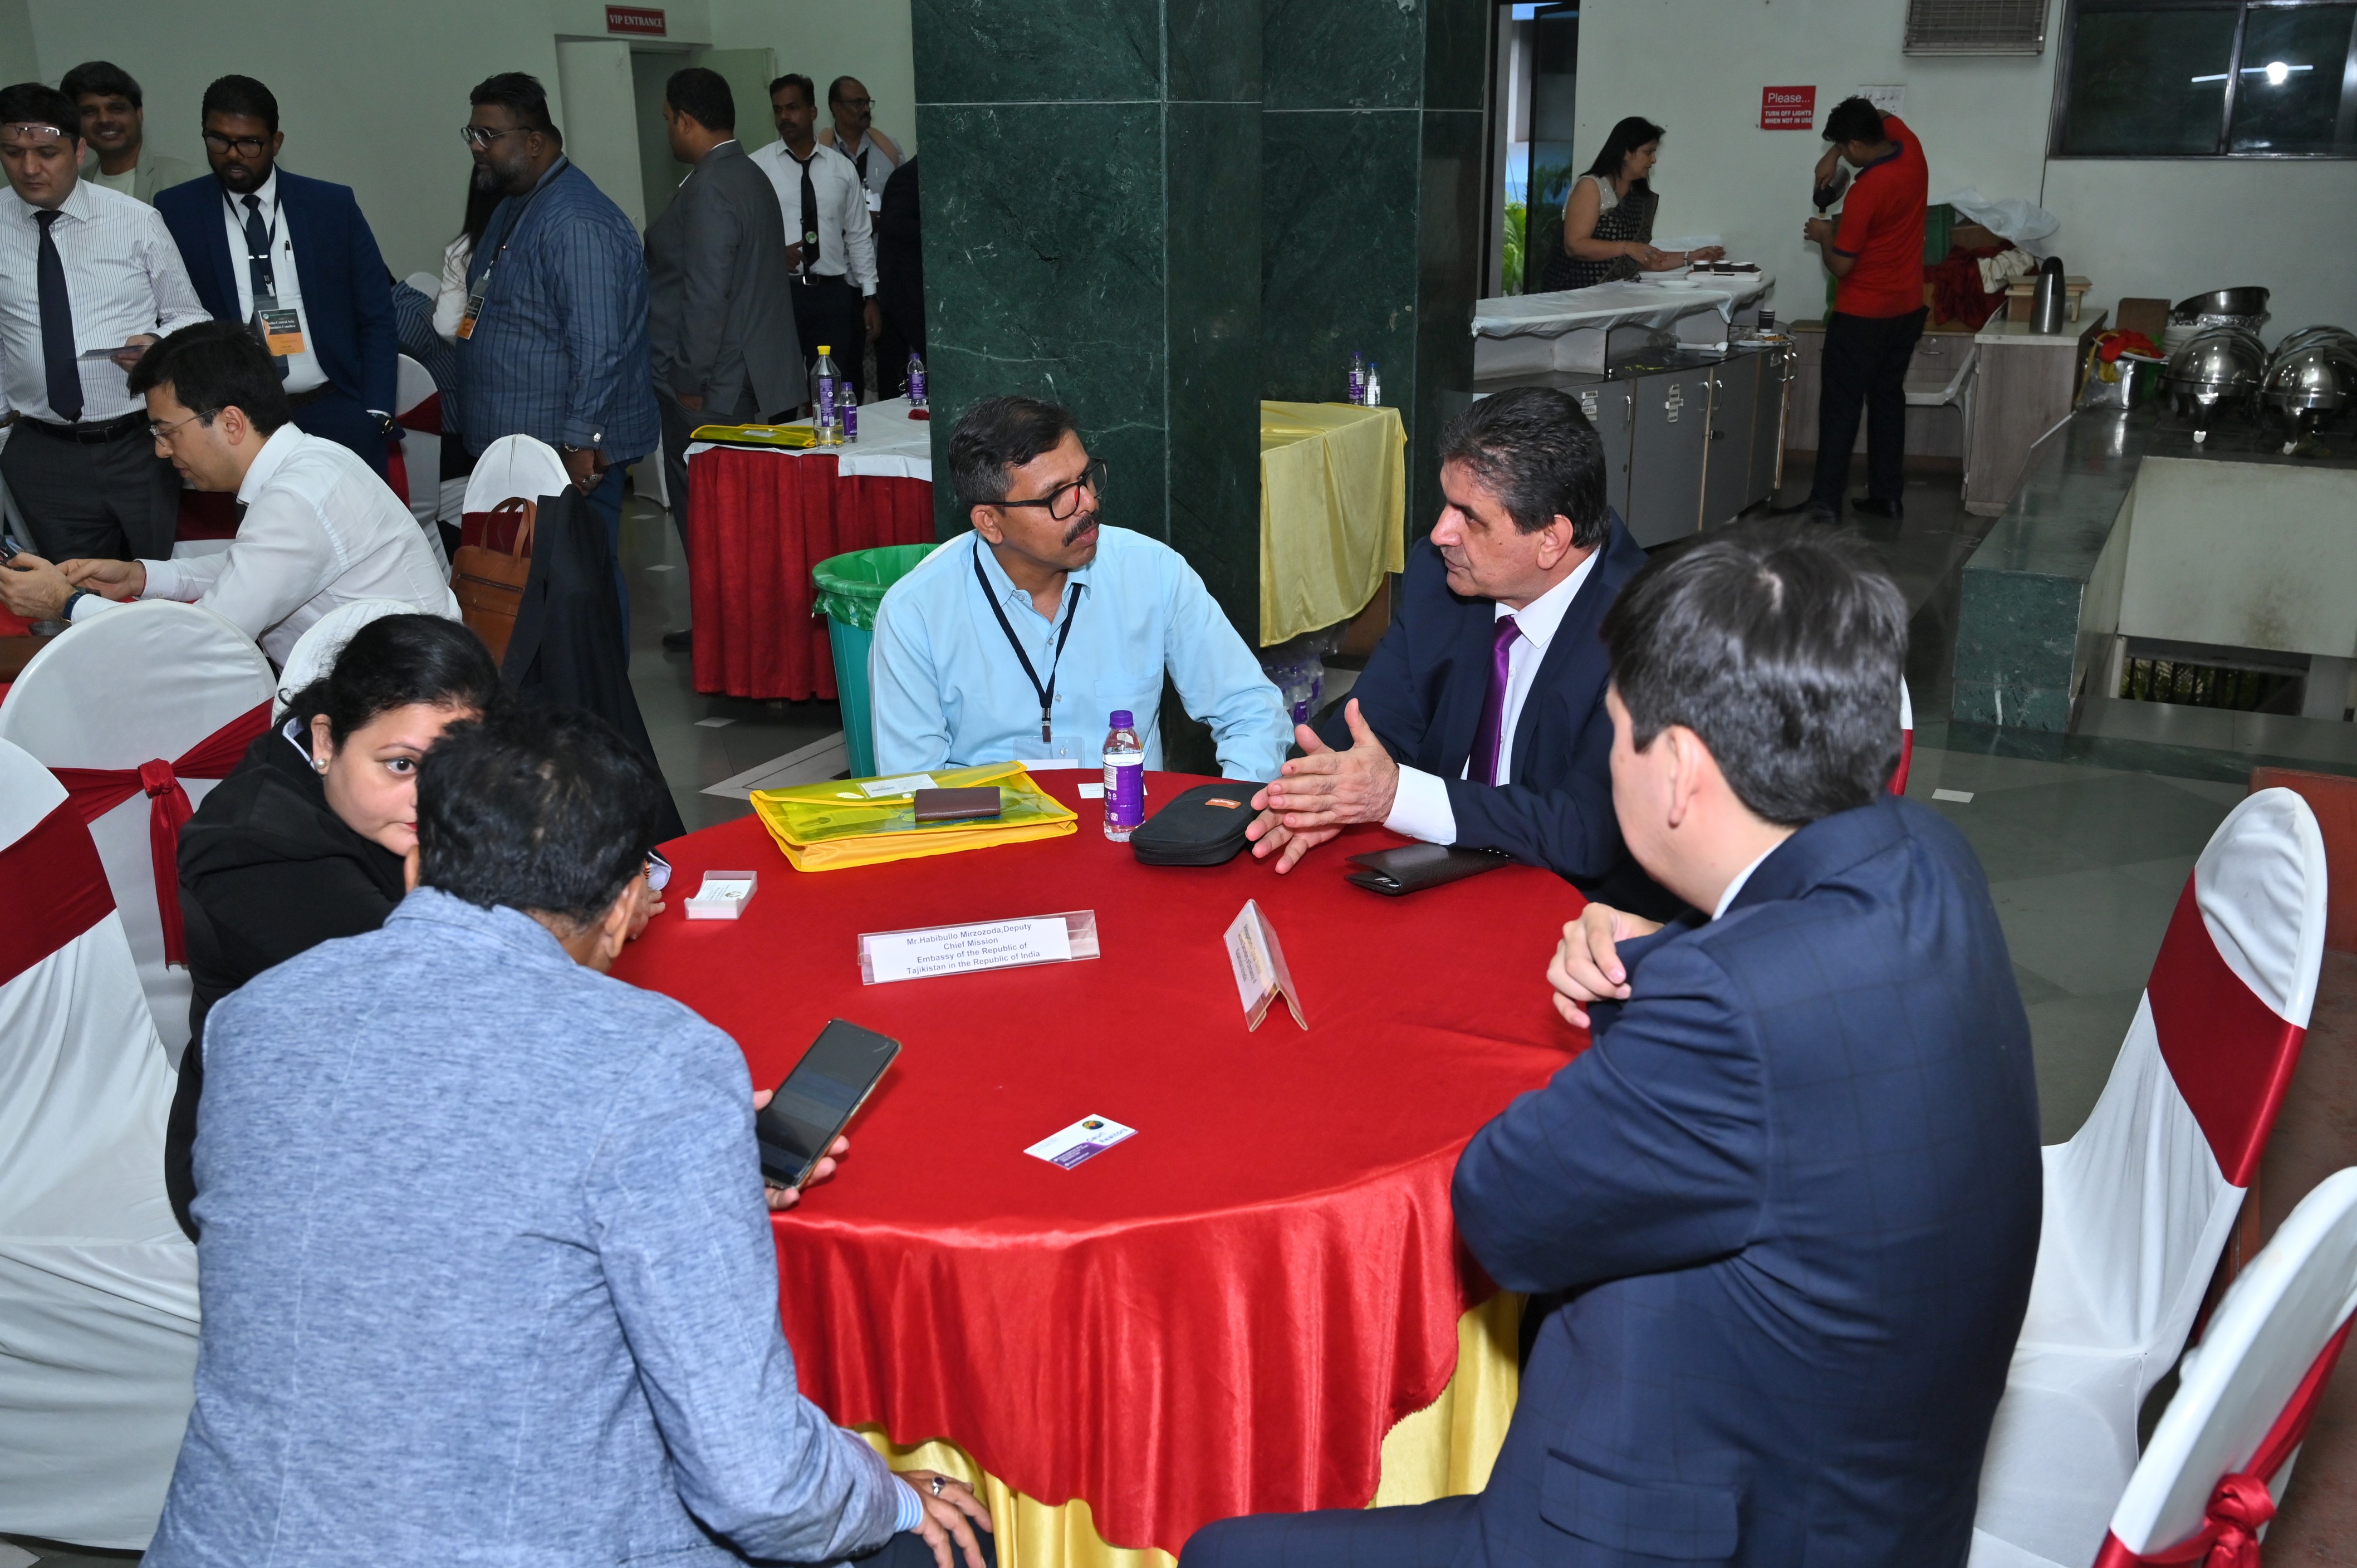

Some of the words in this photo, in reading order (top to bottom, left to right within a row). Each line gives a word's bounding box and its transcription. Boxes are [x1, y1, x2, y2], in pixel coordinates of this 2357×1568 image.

[610, 14, 623, 24] VIP
[624, 16, 663, 27] ENTRANCE
[1767, 92, 1810, 103] Please...
[906, 933, 958, 945] Mr.Habibullo
[960, 923, 1031, 938] Mirzozoda,Deputy
[943, 942, 965, 950] Chief
[967, 937, 998, 947] Mission
[917, 952, 954, 963] Embassy
[982, 944, 1017, 955] Republic
[906, 963, 946, 975] Tajikistan
[973, 955, 1008, 966] Republic
